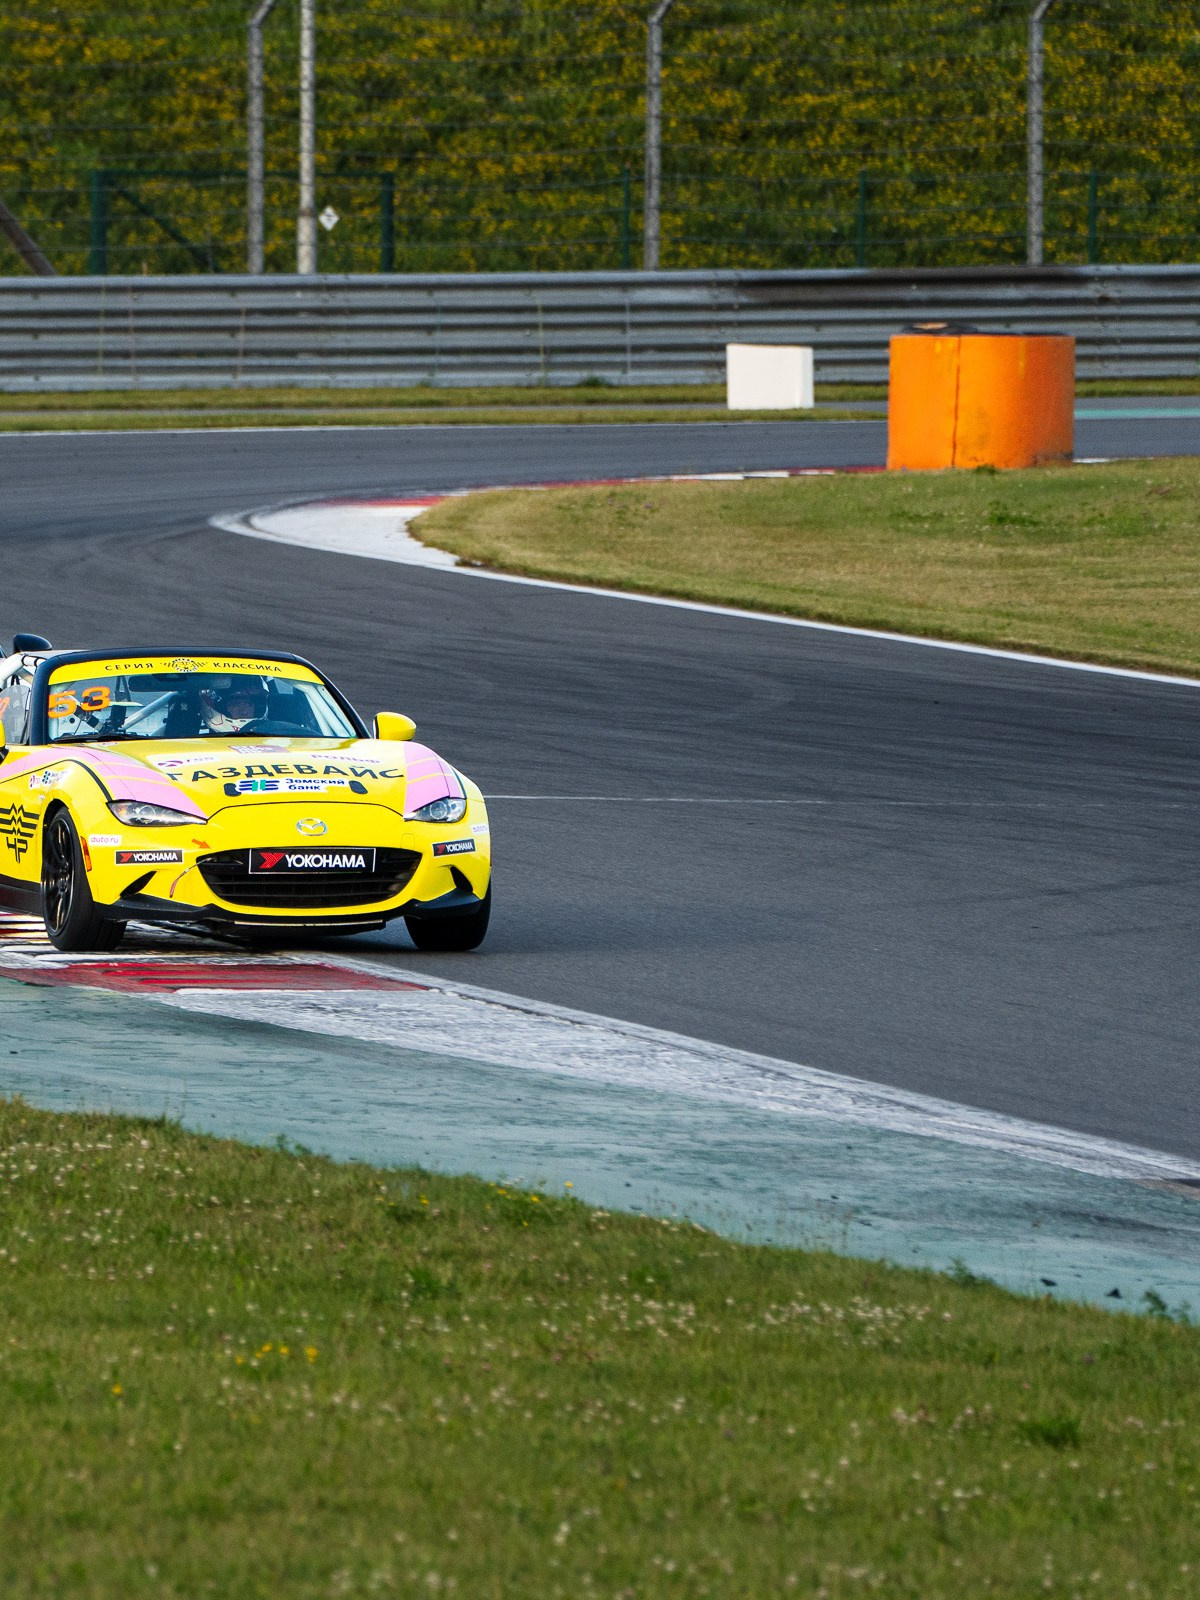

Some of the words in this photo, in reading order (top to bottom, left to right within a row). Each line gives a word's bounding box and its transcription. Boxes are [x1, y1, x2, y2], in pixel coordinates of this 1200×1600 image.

[104, 662, 153, 672] СЕРИЯ
[212, 662, 282, 672] КЛАССИКА
[47, 686, 111, 719] 53
[288, 783, 321, 791] банк
[446, 842, 474, 853] YOKOHAMA
[133, 852, 178, 862] YOKOHAMA
[285, 854, 366, 868] YOKOHAMA
